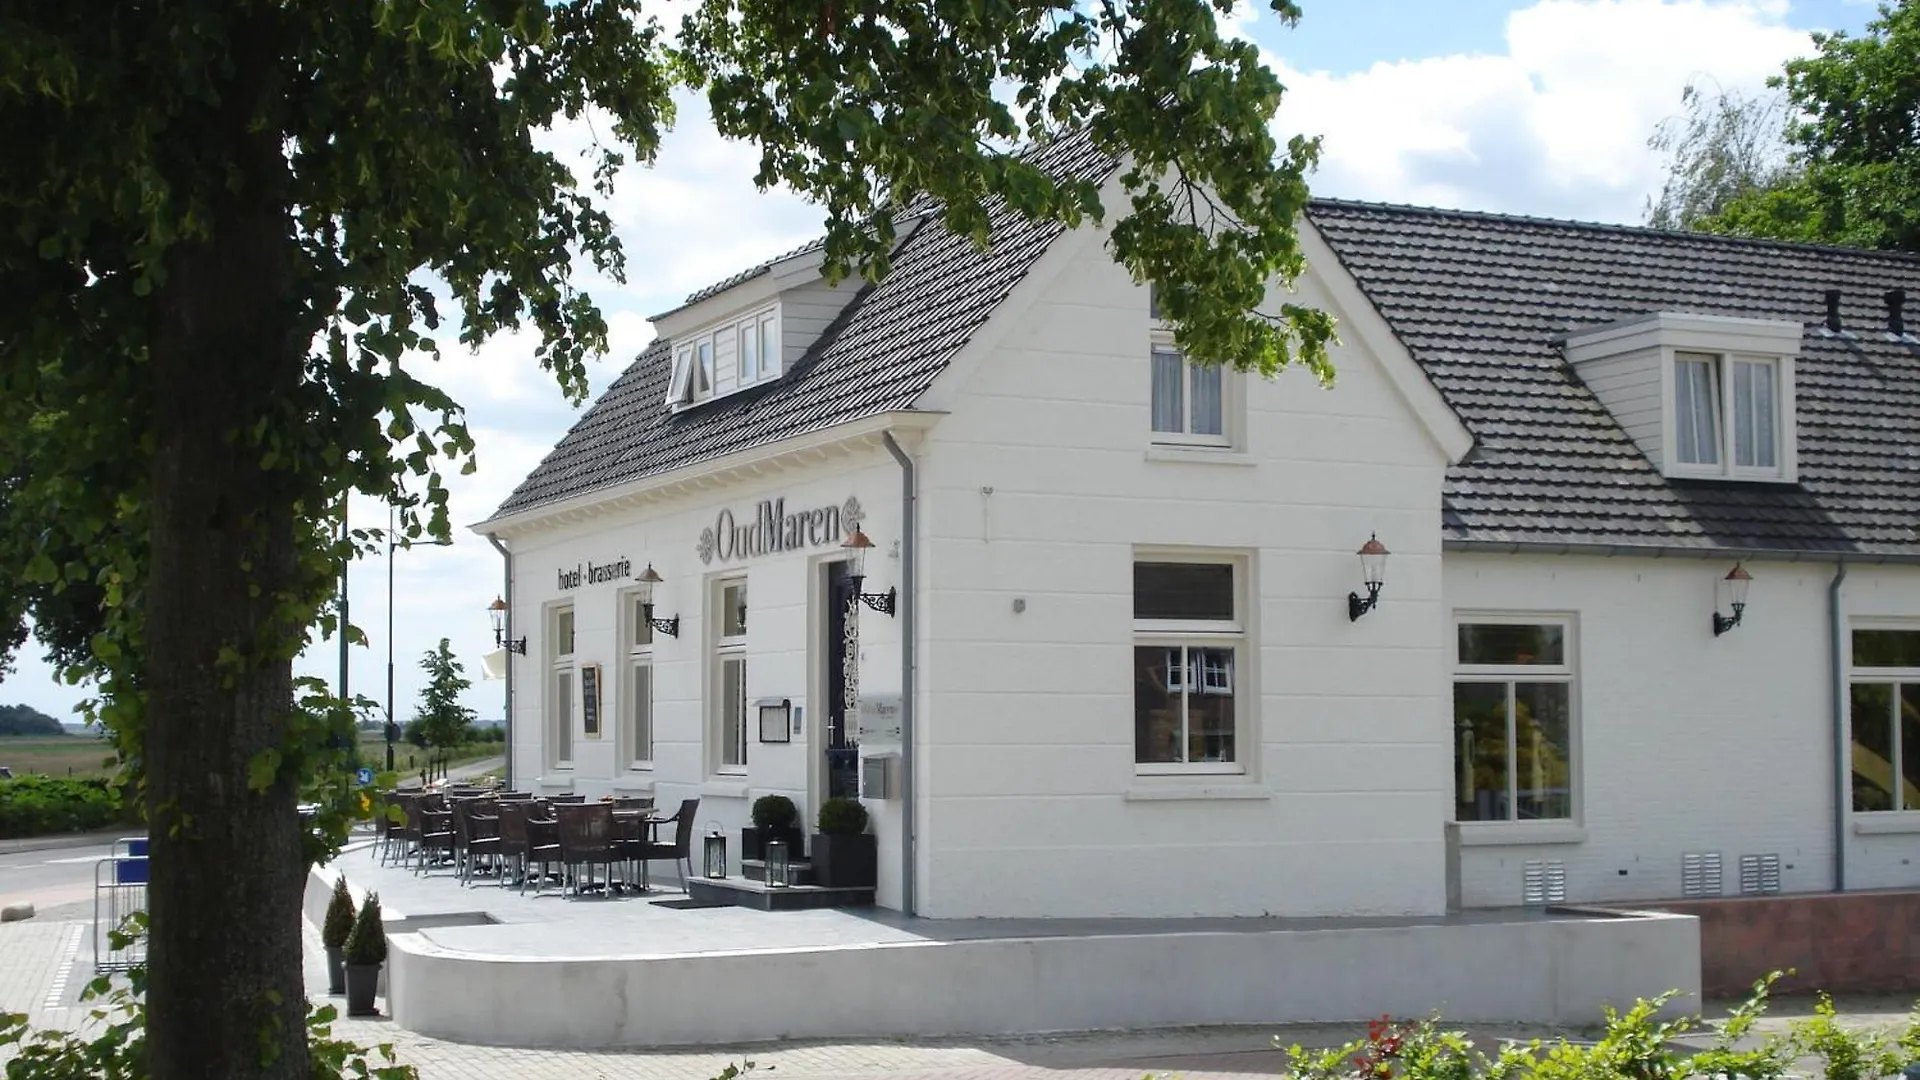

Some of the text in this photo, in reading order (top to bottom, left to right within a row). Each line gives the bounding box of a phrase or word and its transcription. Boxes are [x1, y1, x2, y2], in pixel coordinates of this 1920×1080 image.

[716, 496, 840, 562] OudMaren
[558, 555, 630, 590] hotel brasserie
